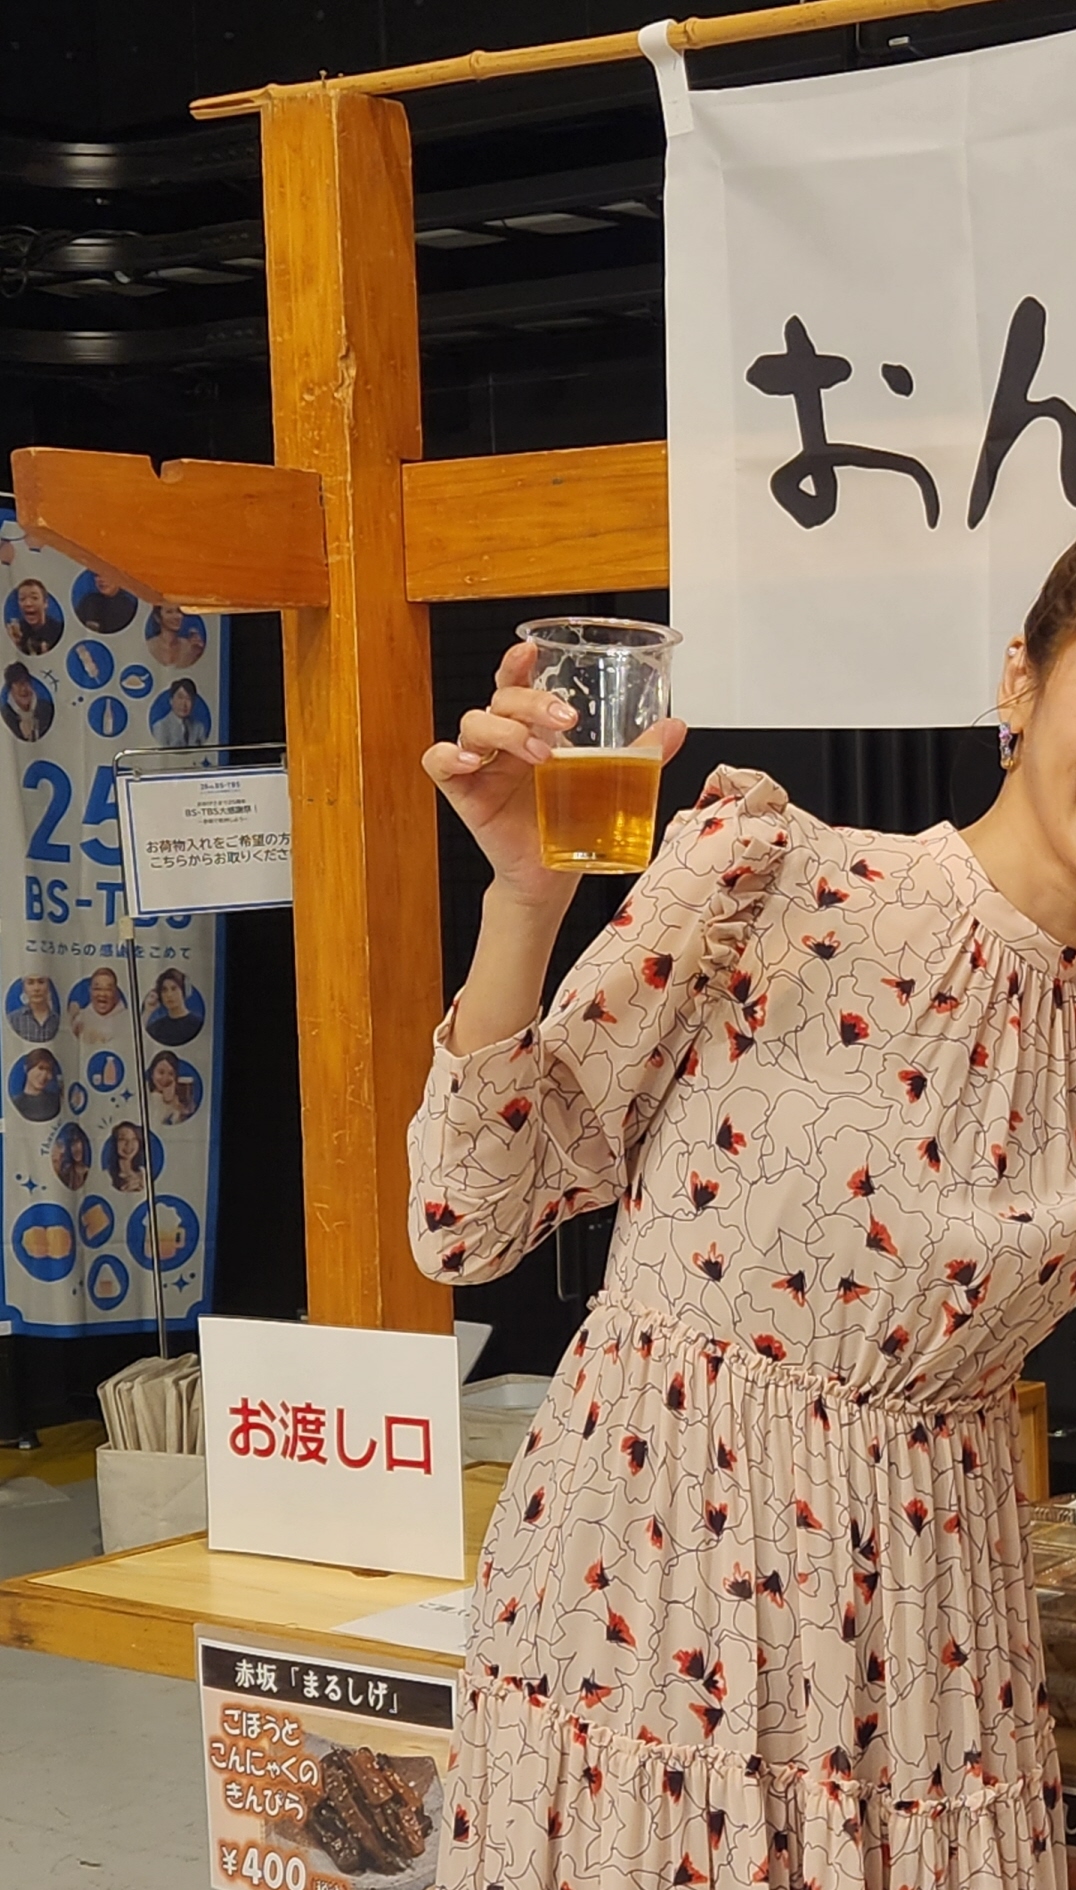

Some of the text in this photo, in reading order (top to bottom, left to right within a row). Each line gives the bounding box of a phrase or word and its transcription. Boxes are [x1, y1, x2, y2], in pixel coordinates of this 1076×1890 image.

[146, 832, 291, 853] お荷物入れをご希望の方
[151, 848, 292, 869] こちらからお取りくださ
[25, 875, 193, 929] BS-T
[228, 1397, 432, 1475] お渡し口
[234, 1658, 398, 1714] 赤坂「まるしげ」
[210, 1742, 318, 1786] こんにゃくの
[221, 1847, 306, 1890] ¥400
